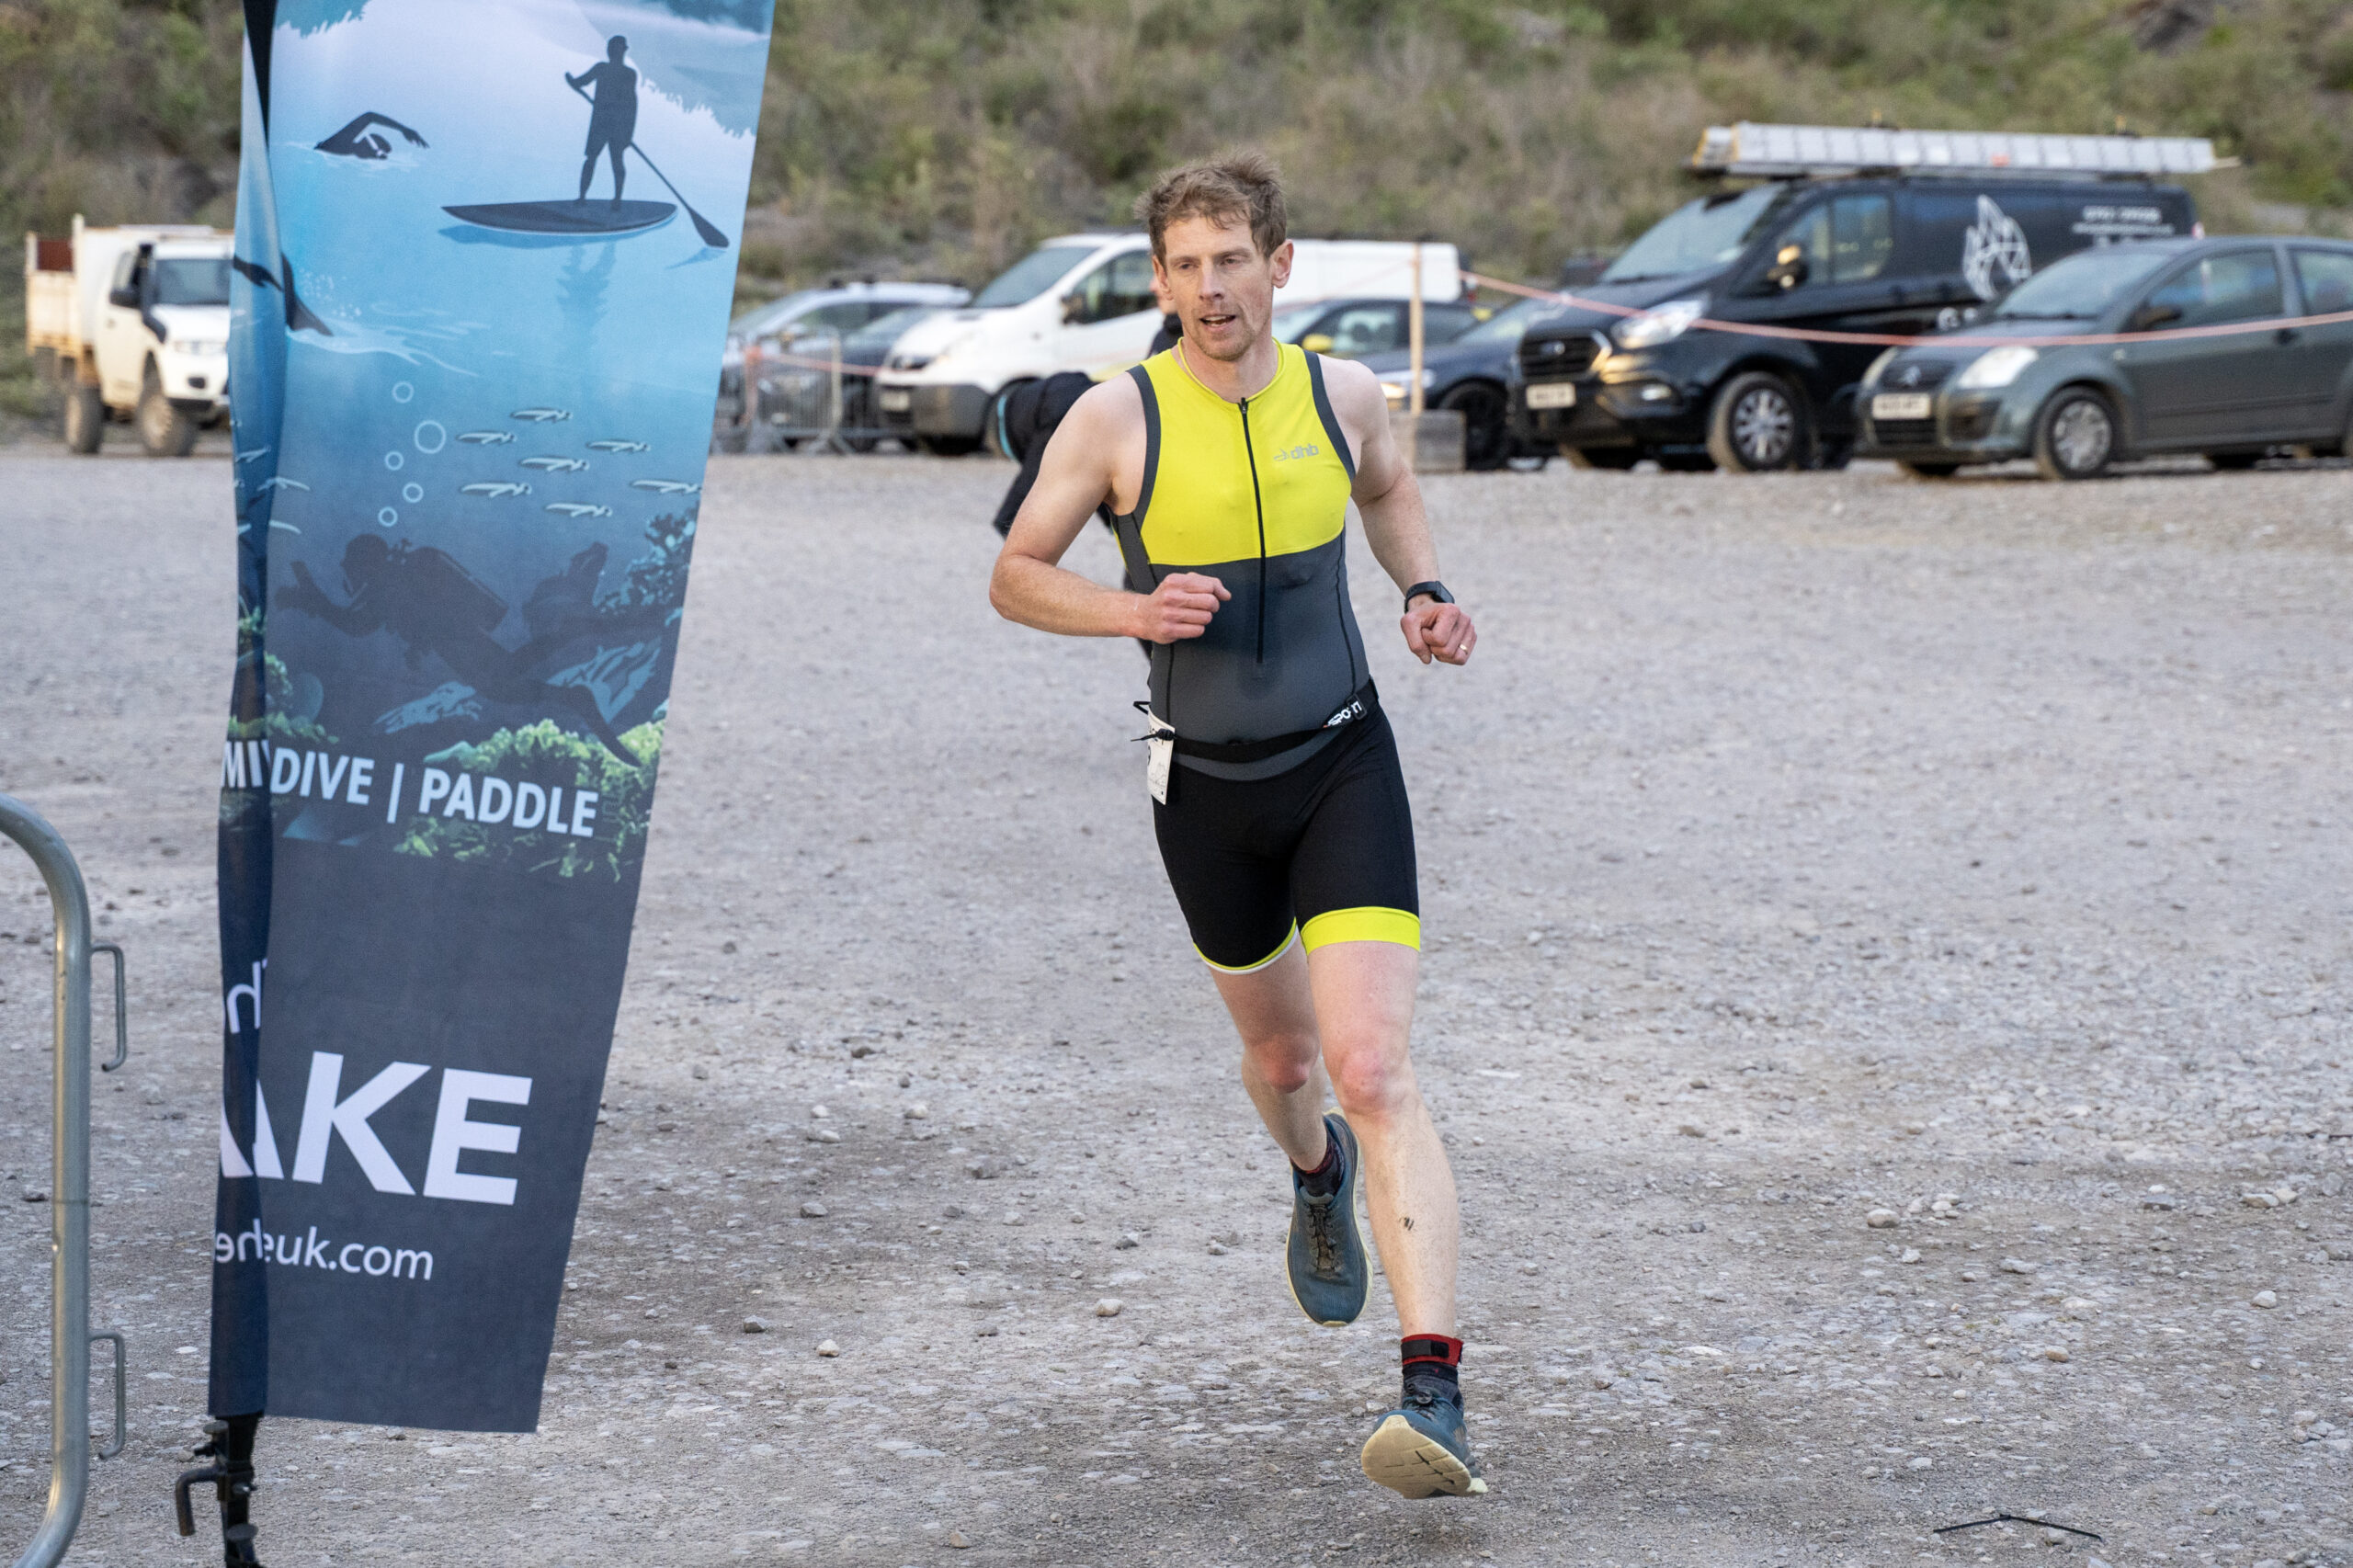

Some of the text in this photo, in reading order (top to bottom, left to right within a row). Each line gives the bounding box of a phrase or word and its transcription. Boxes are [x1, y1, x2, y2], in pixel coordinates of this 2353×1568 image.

[1290, 443, 1319, 460] dhb
[269, 747, 375, 805] DIVE
[418, 768, 599, 837] PADDLE
